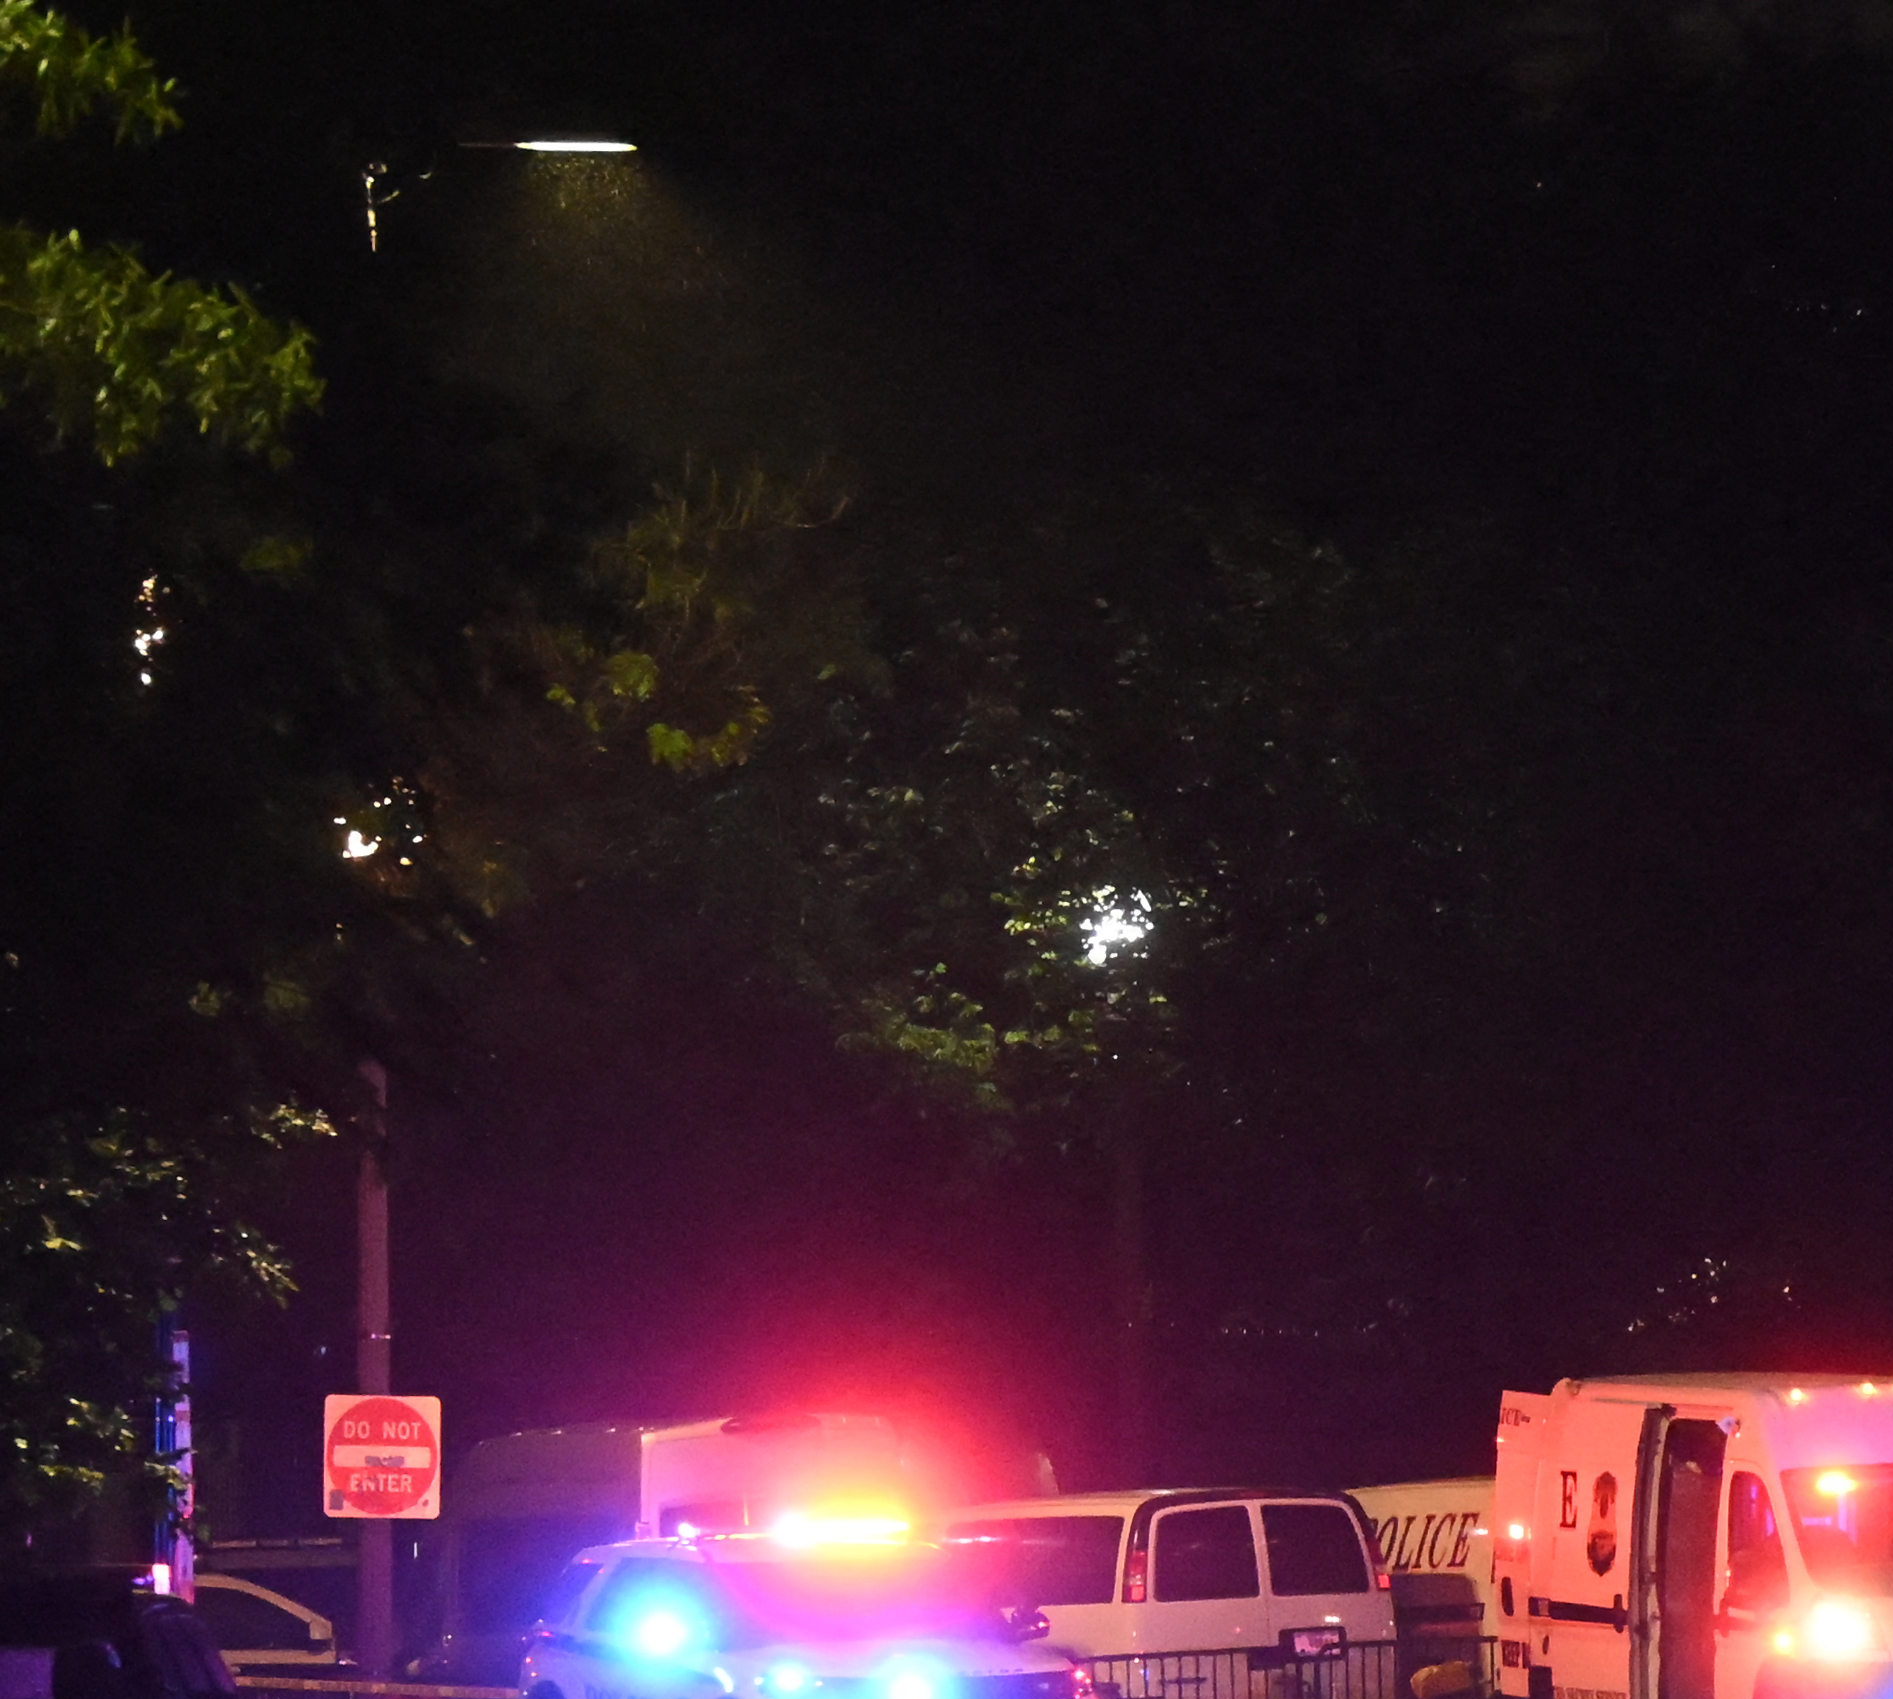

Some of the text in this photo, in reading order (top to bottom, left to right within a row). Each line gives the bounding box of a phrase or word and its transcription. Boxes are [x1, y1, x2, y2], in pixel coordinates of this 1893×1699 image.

[343, 1420, 421, 1440] DO NOT
[349, 1473, 412, 1493] ENTER
